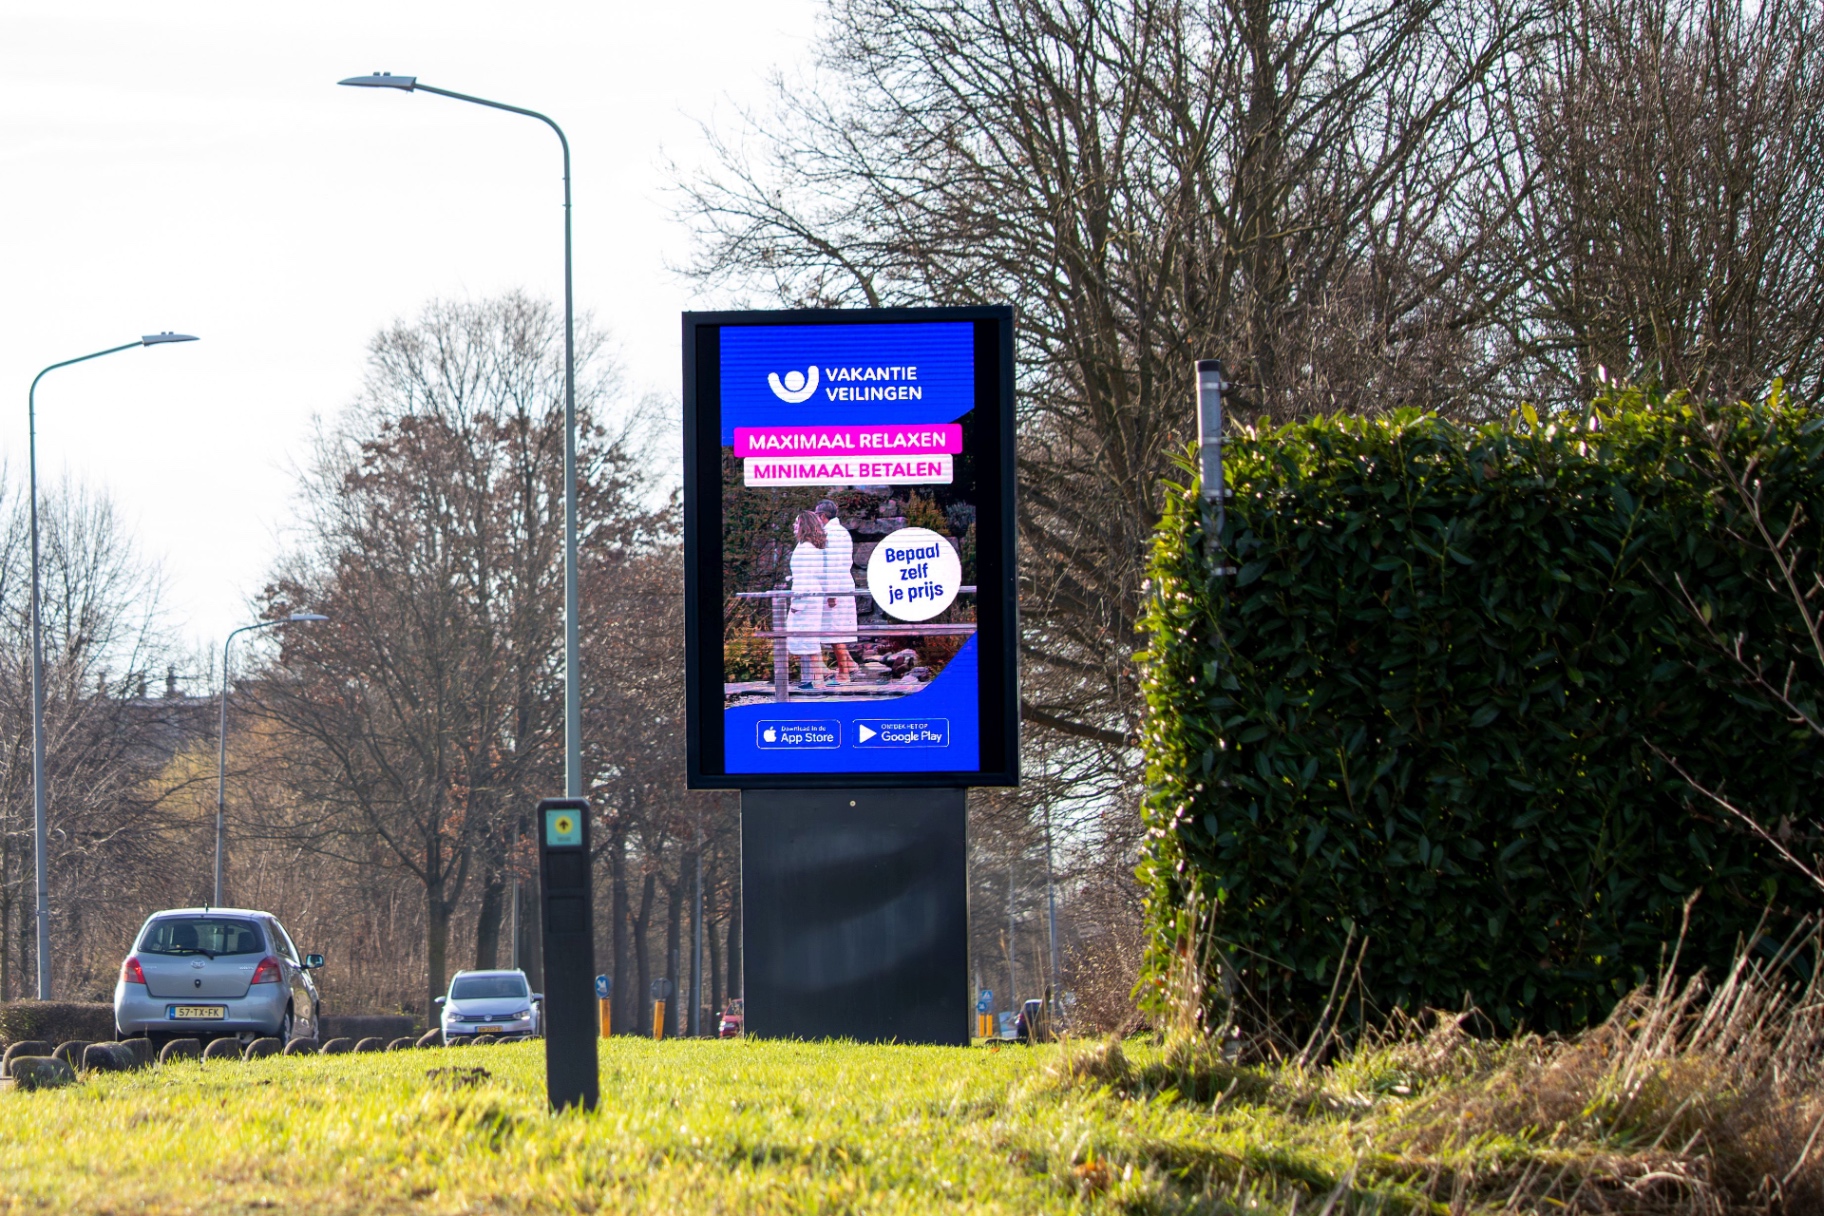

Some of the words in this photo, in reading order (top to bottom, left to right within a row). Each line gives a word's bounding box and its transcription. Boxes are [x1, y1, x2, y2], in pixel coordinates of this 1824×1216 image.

[825, 366, 917, 382] VAKANTIE
[825, 386, 922, 401] VEILINGEN
[749, 433, 855, 450] MAXIMAAL
[859, 432, 946, 448] RELAXEN
[754, 463, 854, 479] MINIMAAL
[859, 462, 942, 477] BETALEN
[885, 542, 940, 565] Bepaal
[899, 562, 928, 581] zelf
[889, 585, 904, 605] je
[907, 581, 944, 603] prijs
[780, 732, 803, 745] App
[805, 732, 834, 743] Store
[881, 730, 919, 744] Google
[921, 730, 943, 743] Play
[178, 1008, 220, 1017] 57-TX-FK
